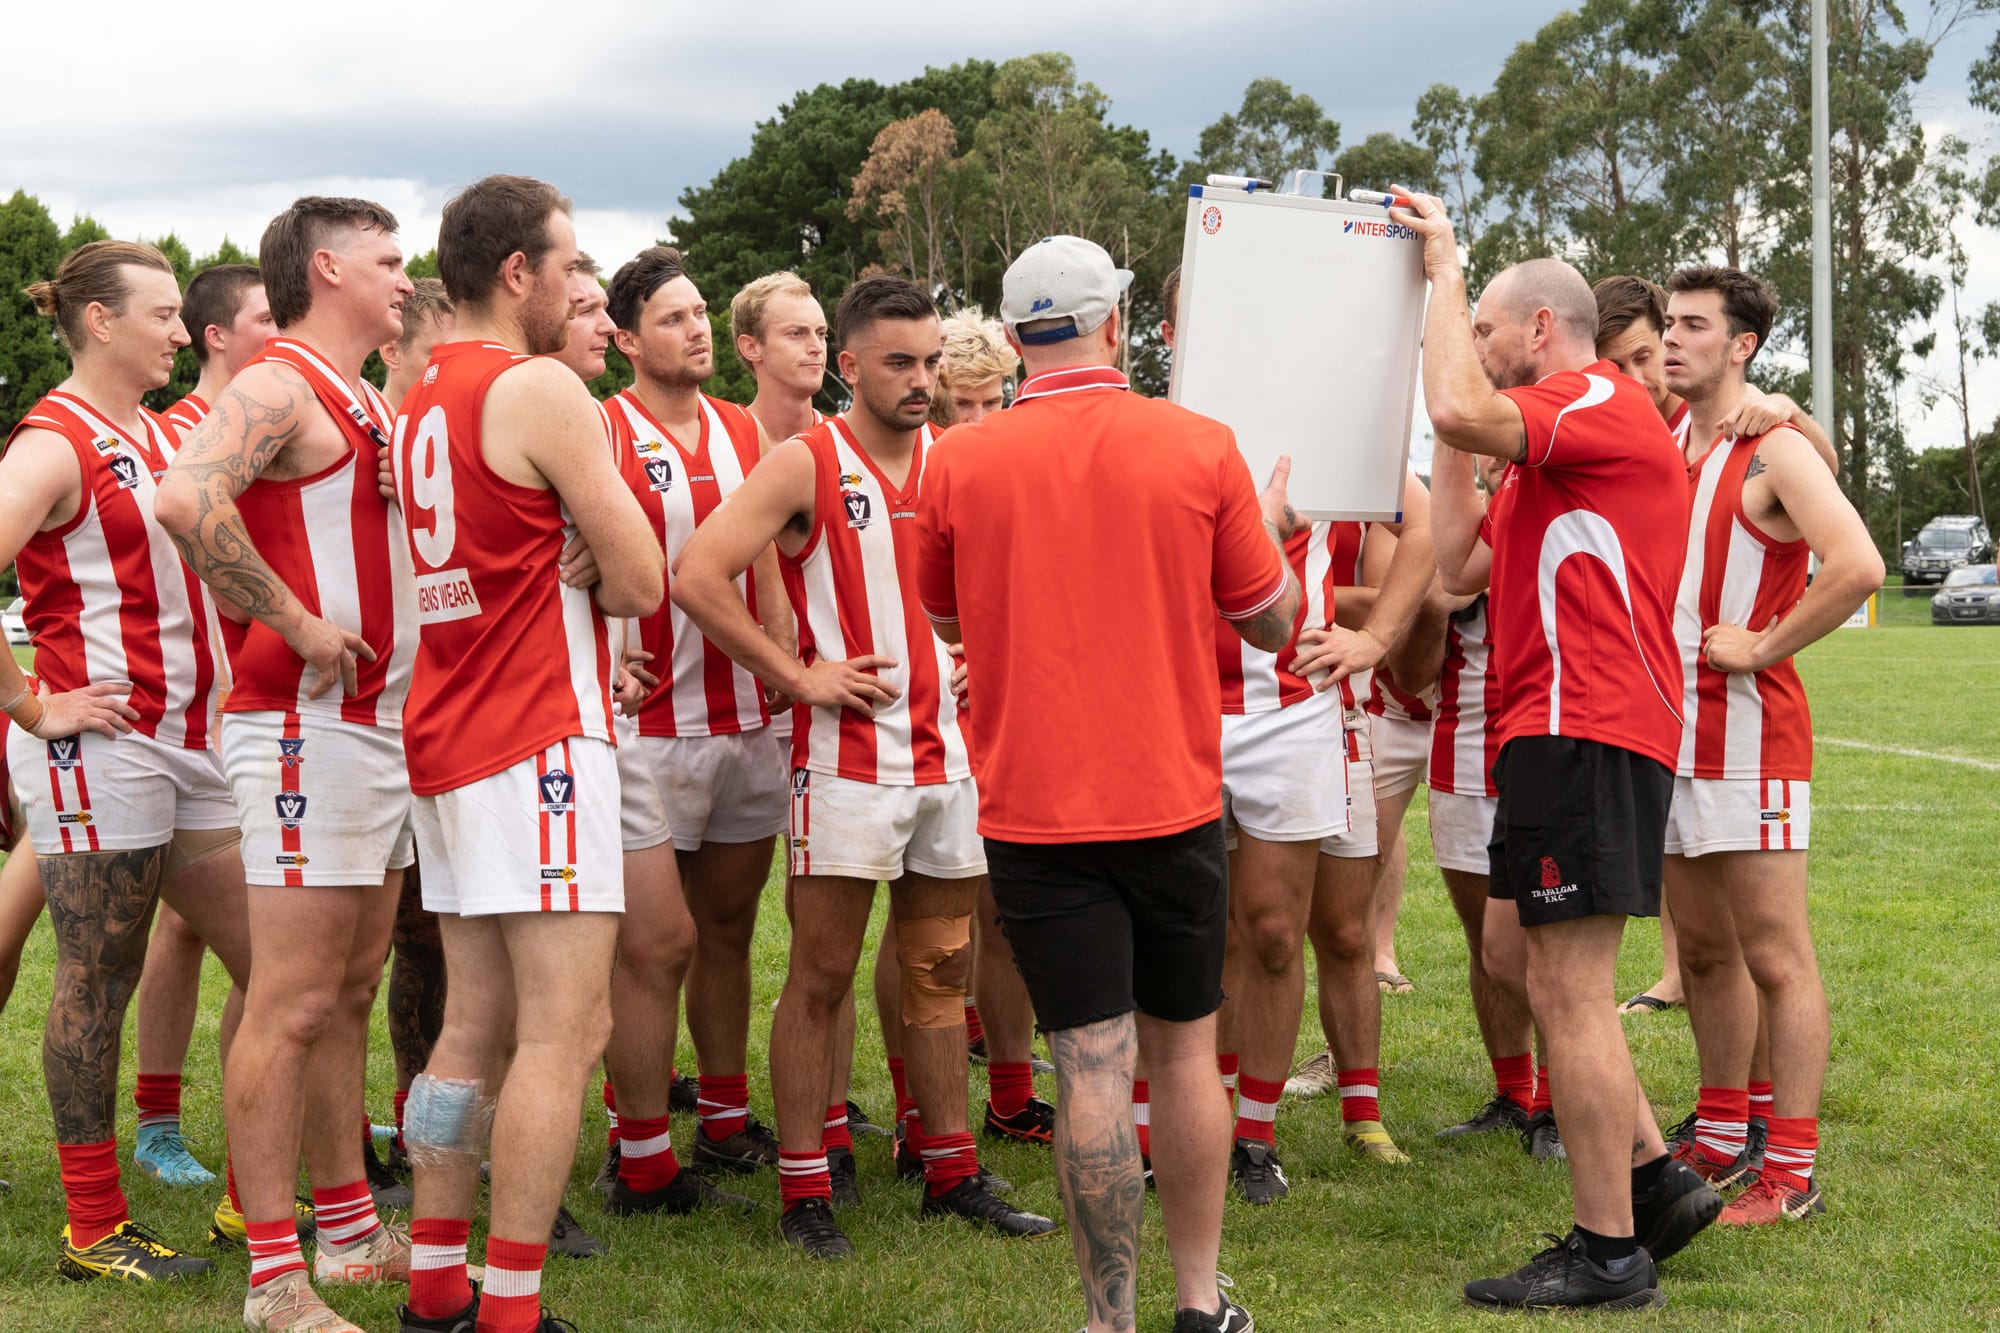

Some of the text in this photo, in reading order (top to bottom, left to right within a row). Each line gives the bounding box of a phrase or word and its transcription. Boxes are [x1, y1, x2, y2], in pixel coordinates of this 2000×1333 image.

[1354, 221, 1418, 240] INTERSPORT
[438, 580, 474, 609] WEAR
[545, 782, 568, 803] V
[280, 801, 302, 818] V
[1531, 884, 1578, 898] TRAFALGAR
